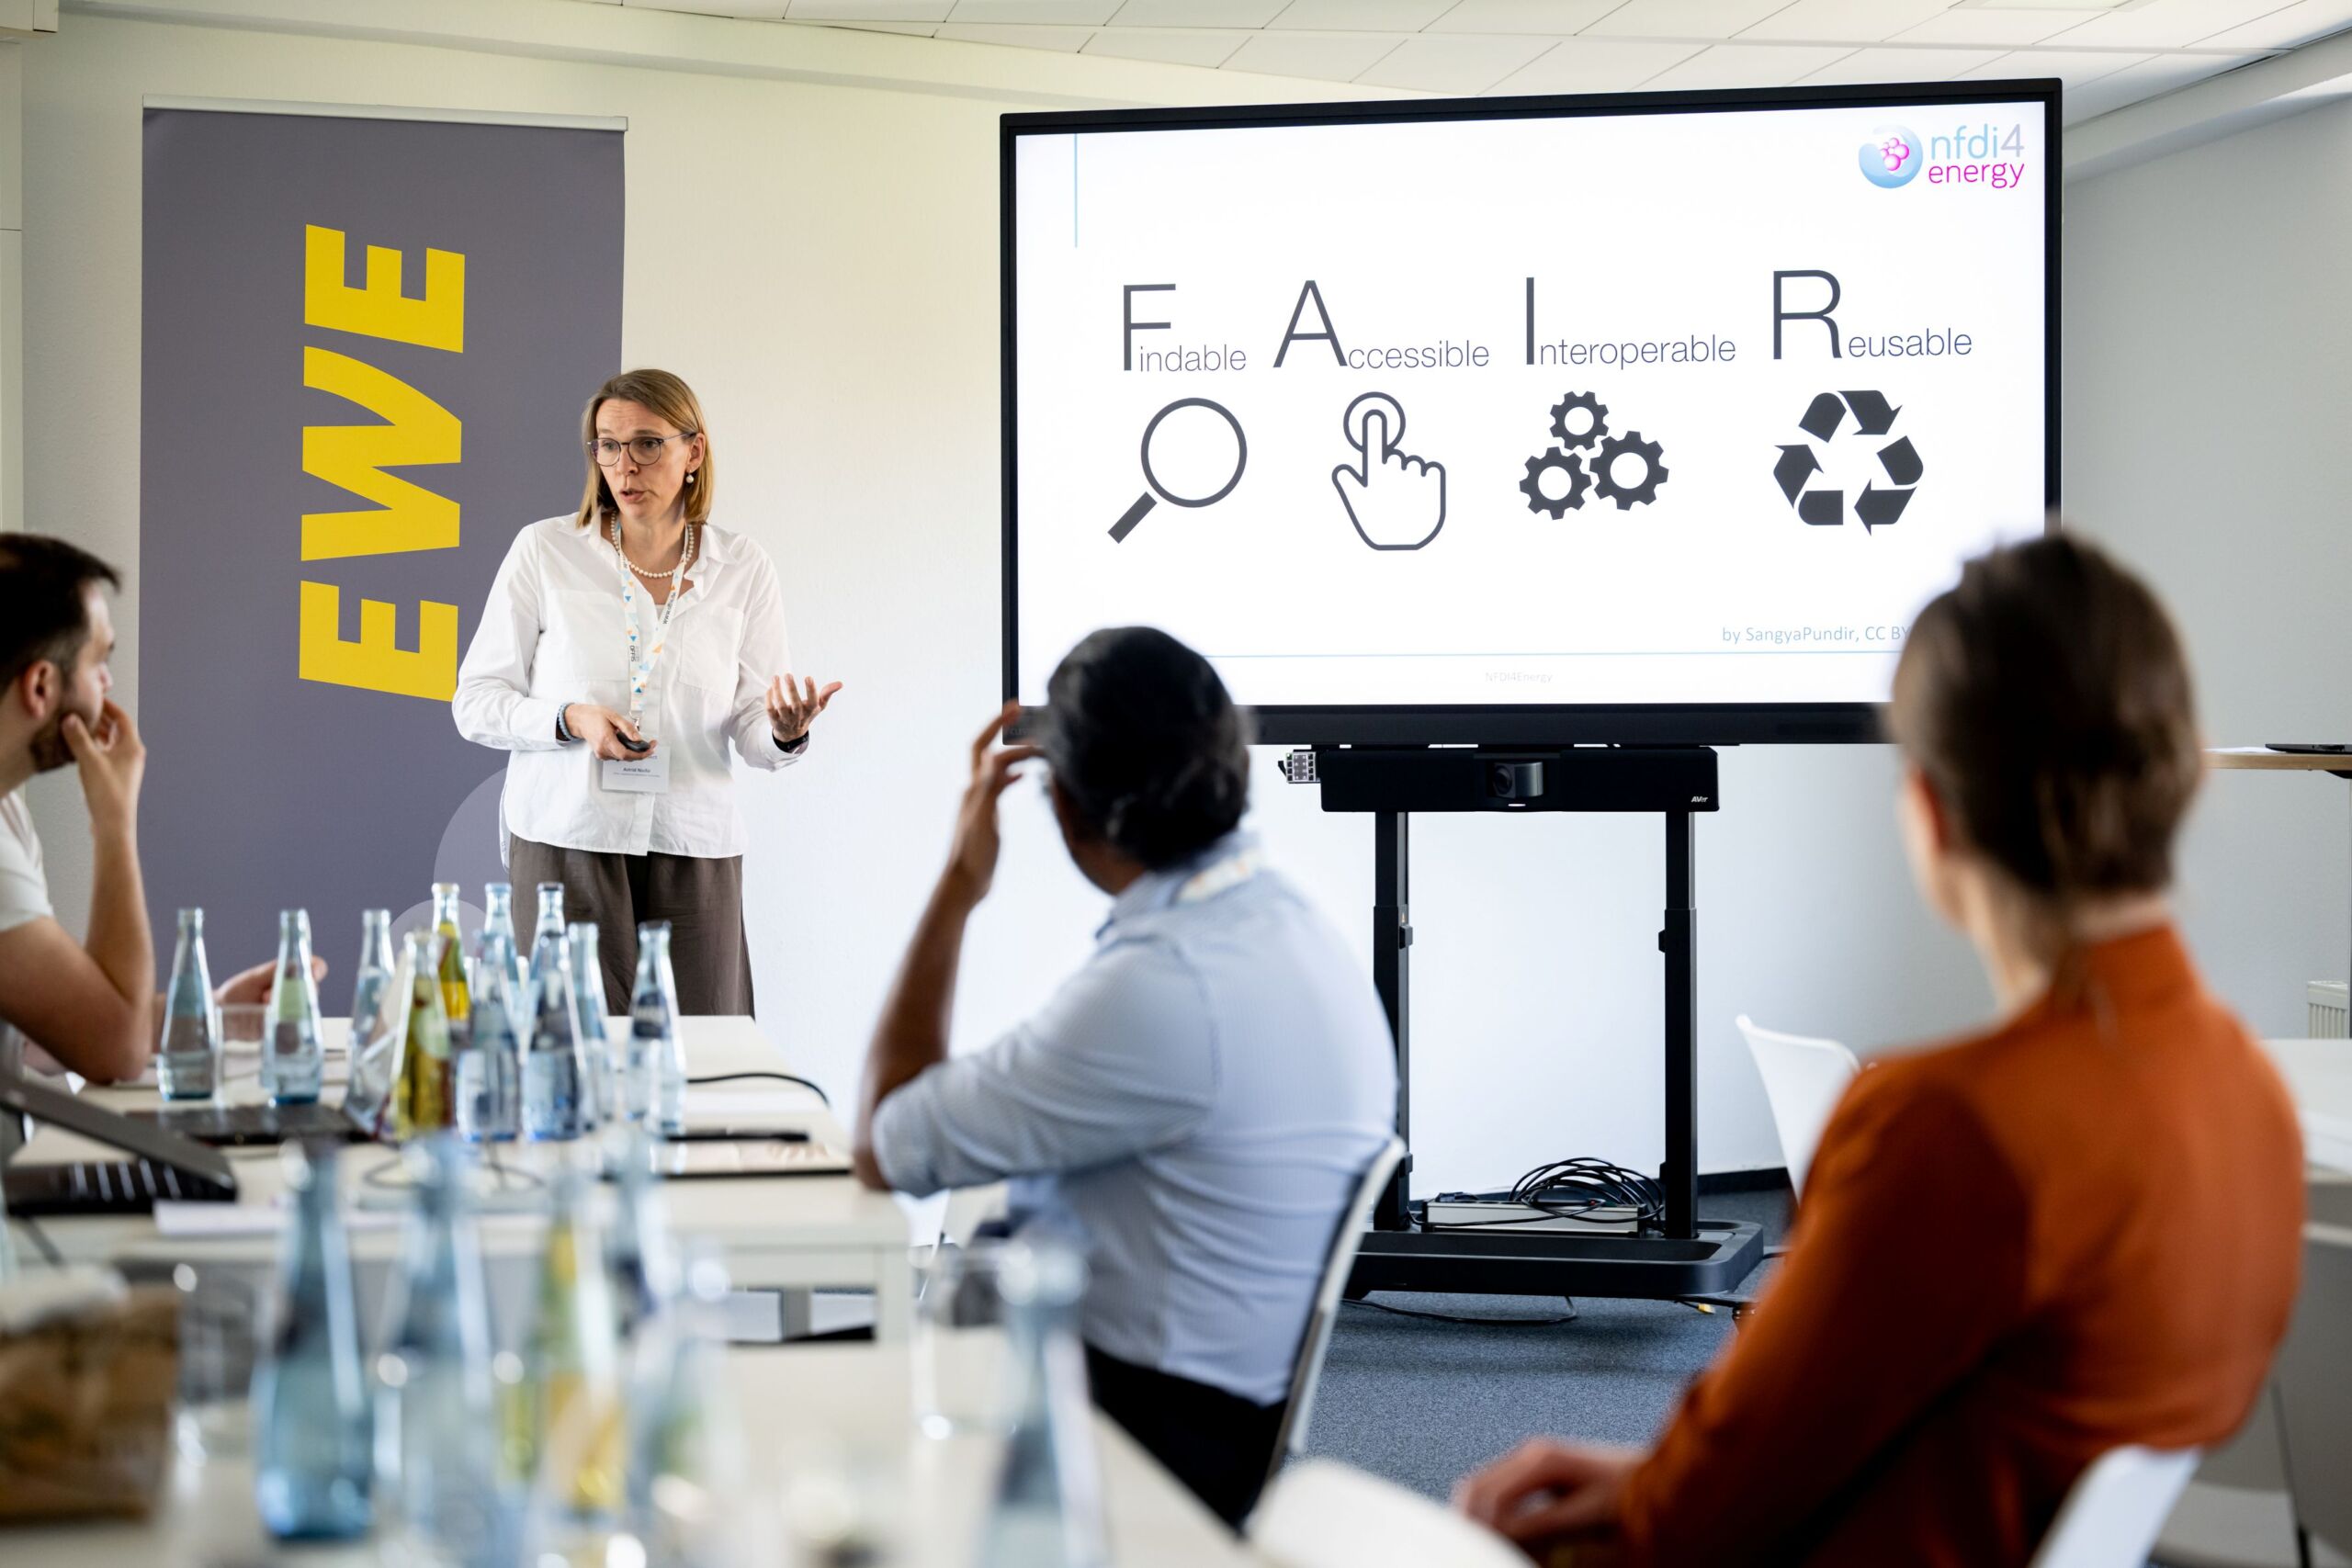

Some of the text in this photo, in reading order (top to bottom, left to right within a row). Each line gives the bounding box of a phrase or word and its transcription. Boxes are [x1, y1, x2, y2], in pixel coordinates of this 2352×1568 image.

[1931, 123, 2025, 159] nfdi4
[1928, 163, 2025, 189] energy
[1123, 269, 1973, 372] Findable Accessible Interoperable Reusable
[299, 223, 465, 702] EWE
[1722, 626, 1741, 645] by
[1746, 626, 1860, 645] SangyaPundir,
[1865, 626, 1885, 640] CC
[1485, 671, 1554, 684] NFDI4Energy
